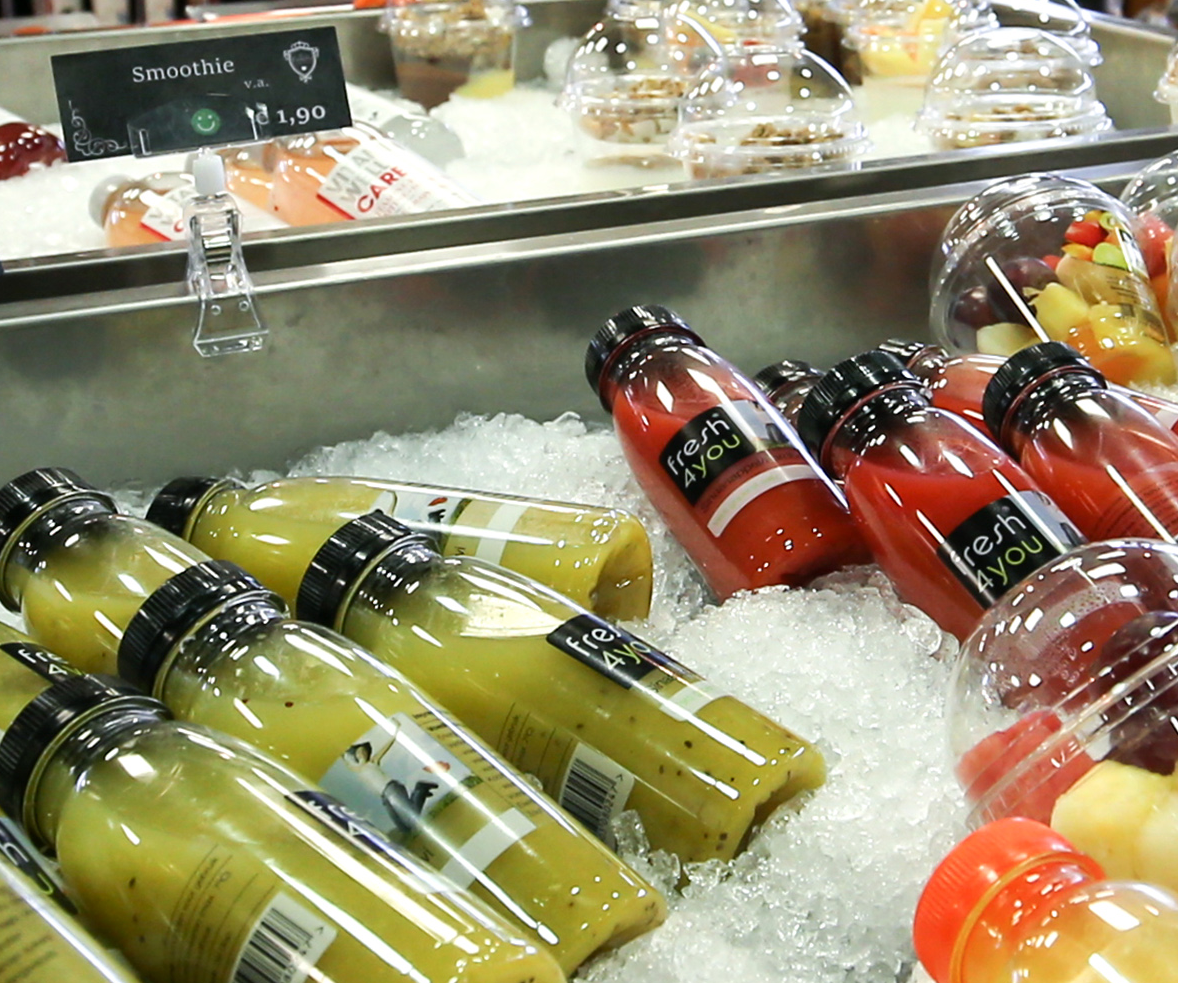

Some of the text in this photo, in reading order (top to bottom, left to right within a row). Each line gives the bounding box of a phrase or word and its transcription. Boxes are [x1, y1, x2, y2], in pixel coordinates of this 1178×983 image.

[132, 57, 235, 82] Smoothie
[277, 105, 327, 125] 1,90
[357, 166, 408, 213] CARE
[667, 418, 730, 476] fresh
[684, 434, 741, 489] 4you
[977, 535, 1043, 593] 4you
[602, 640, 652, 670] 4yo
